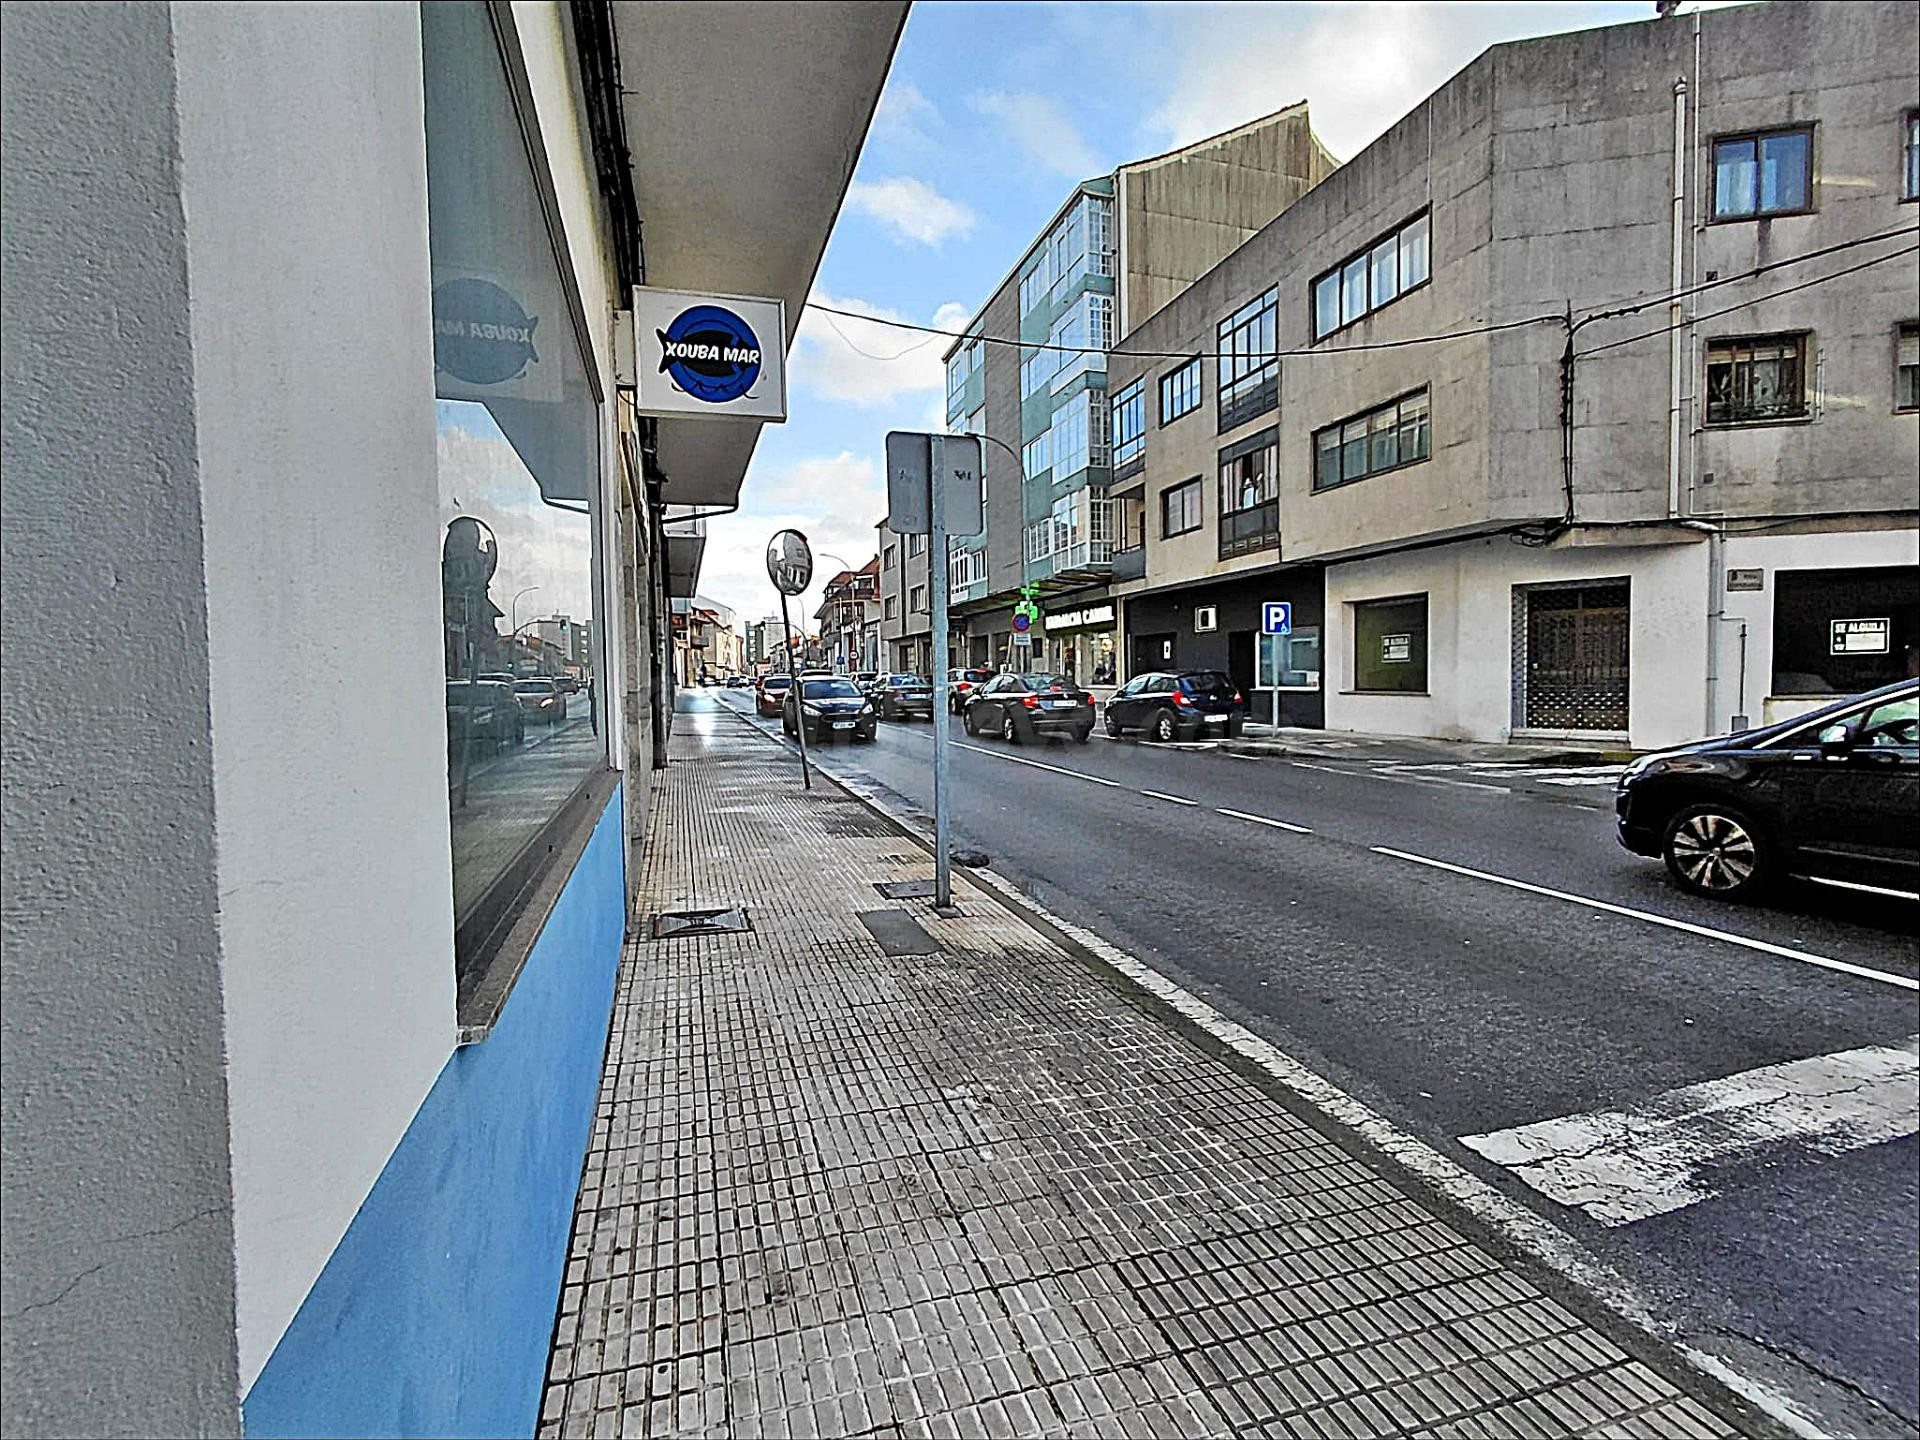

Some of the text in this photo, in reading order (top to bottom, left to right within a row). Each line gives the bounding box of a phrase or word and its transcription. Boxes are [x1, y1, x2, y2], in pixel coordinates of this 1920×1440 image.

[665, 341, 760, 364] XOUBA MAR
[1269, 606, 1286, 631] P
